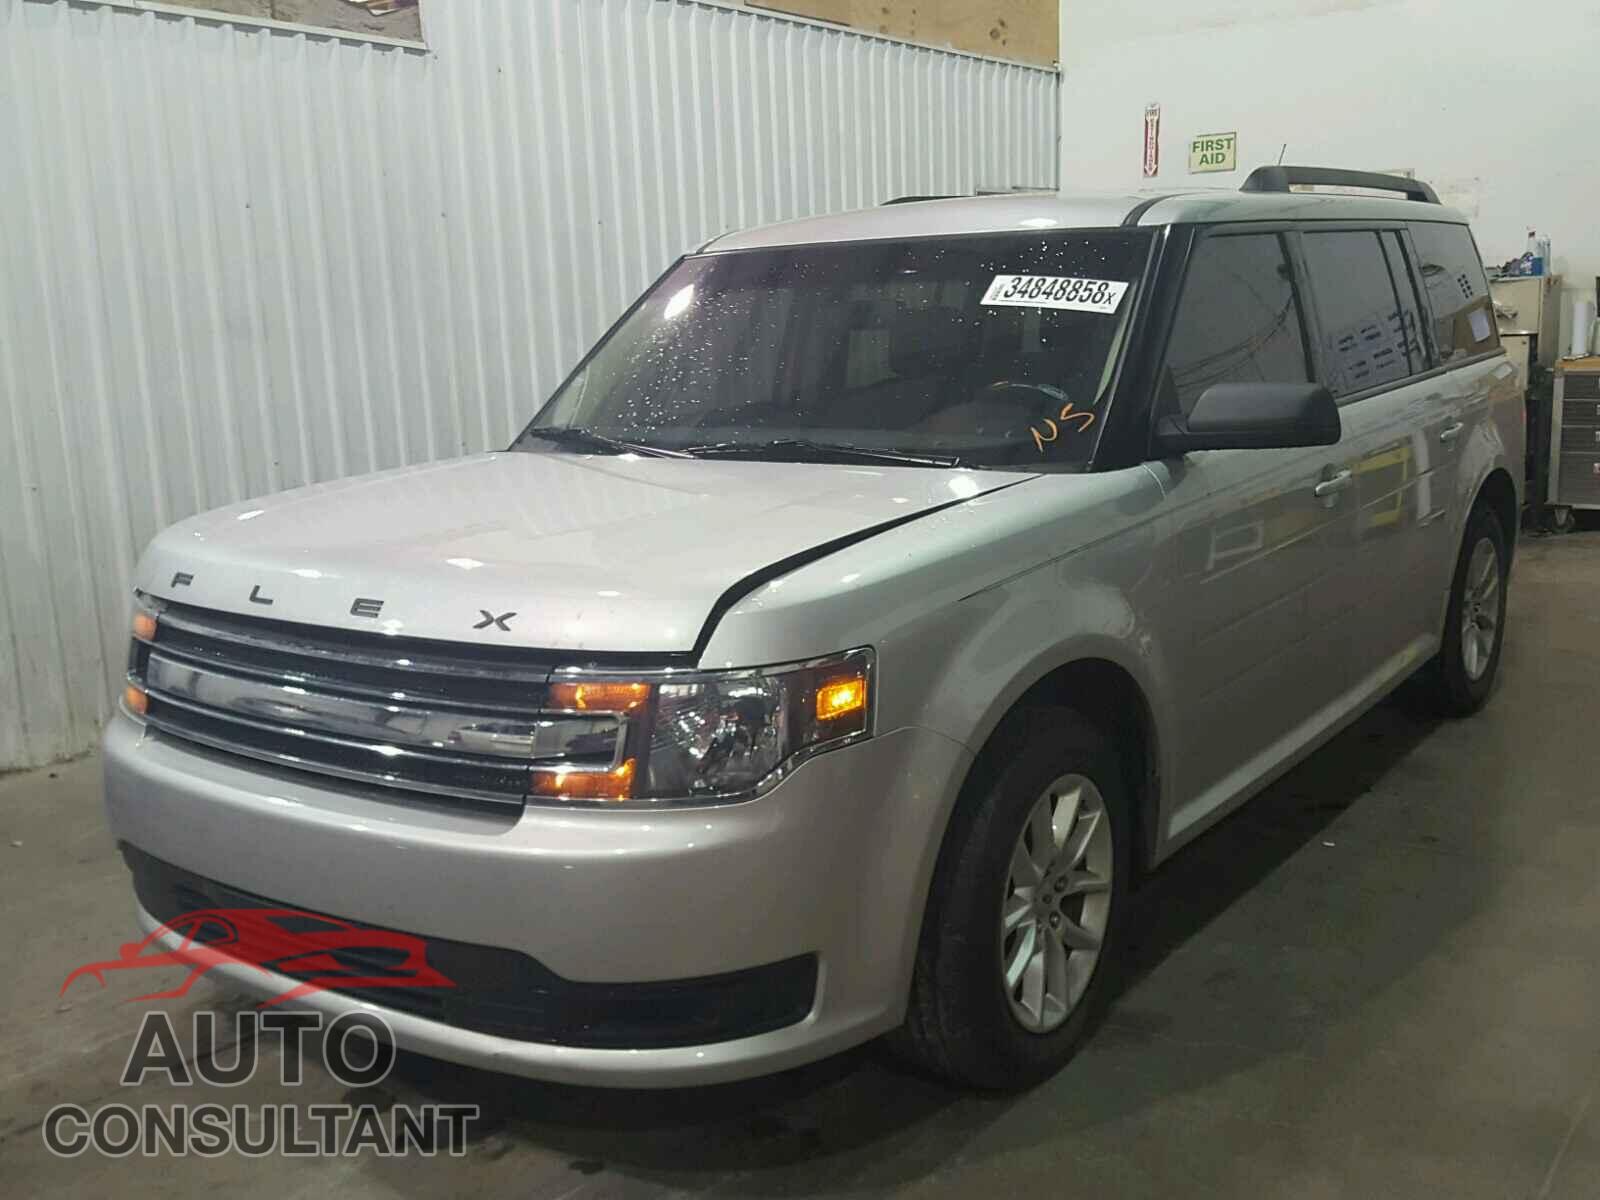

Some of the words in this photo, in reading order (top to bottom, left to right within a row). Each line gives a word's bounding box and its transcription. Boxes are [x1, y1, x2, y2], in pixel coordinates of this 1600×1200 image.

[1192, 138, 1234, 153] FIRST
[1199, 152, 1226, 165] AID
[171, 572, 517, 632] FLEX
